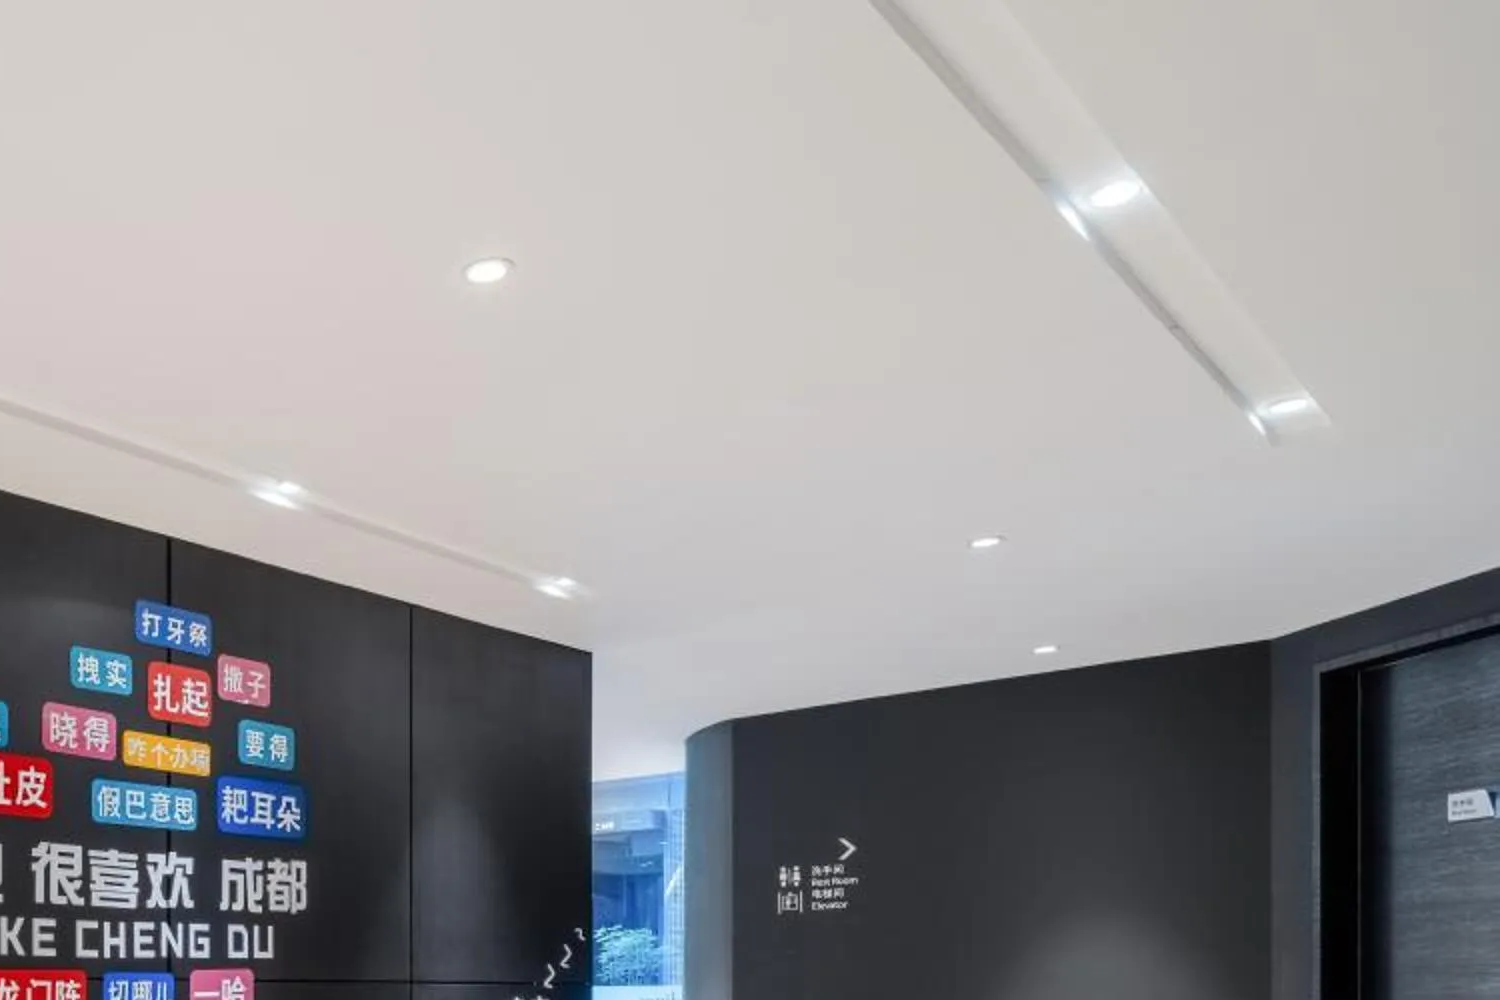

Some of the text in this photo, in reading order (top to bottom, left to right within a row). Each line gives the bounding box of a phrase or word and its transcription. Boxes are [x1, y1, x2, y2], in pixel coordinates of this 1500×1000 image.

[154, 674, 208, 717] 扎起
[50, 712, 110, 752] 晓得
[246, 730, 287, 762] 要得
[98, 786, 194, 824] 假巴意思
[76, 921, 210, 958] CHENG
[228, 925, 273, 958] DU
